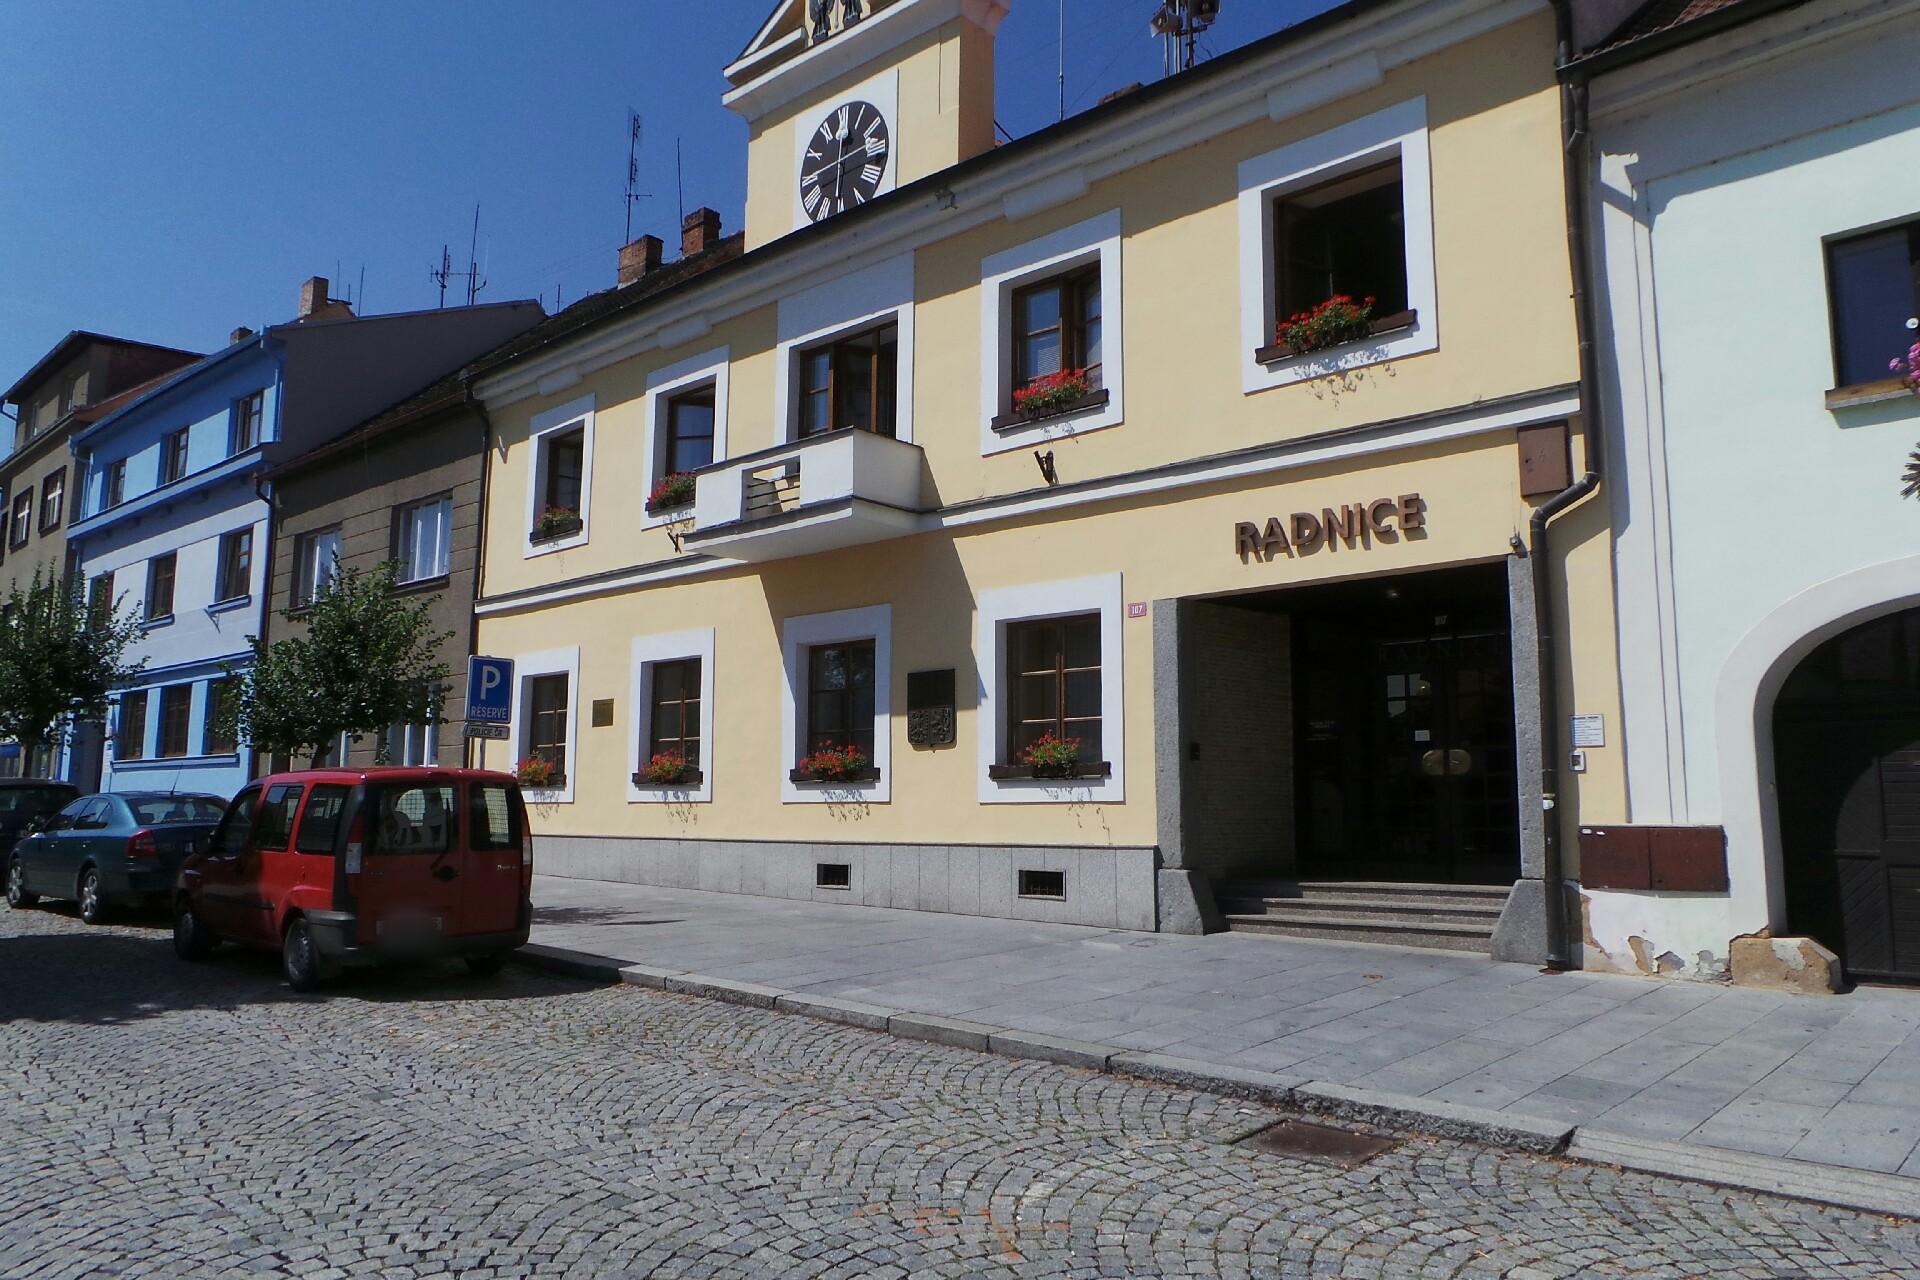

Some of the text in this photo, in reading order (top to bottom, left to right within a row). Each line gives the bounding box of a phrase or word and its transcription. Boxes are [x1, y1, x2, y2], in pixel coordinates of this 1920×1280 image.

[1235, 493, 1421, 560] RADNICE
[1131, 605, 1143, 614] 107
[480, 665, 501, 700] P
